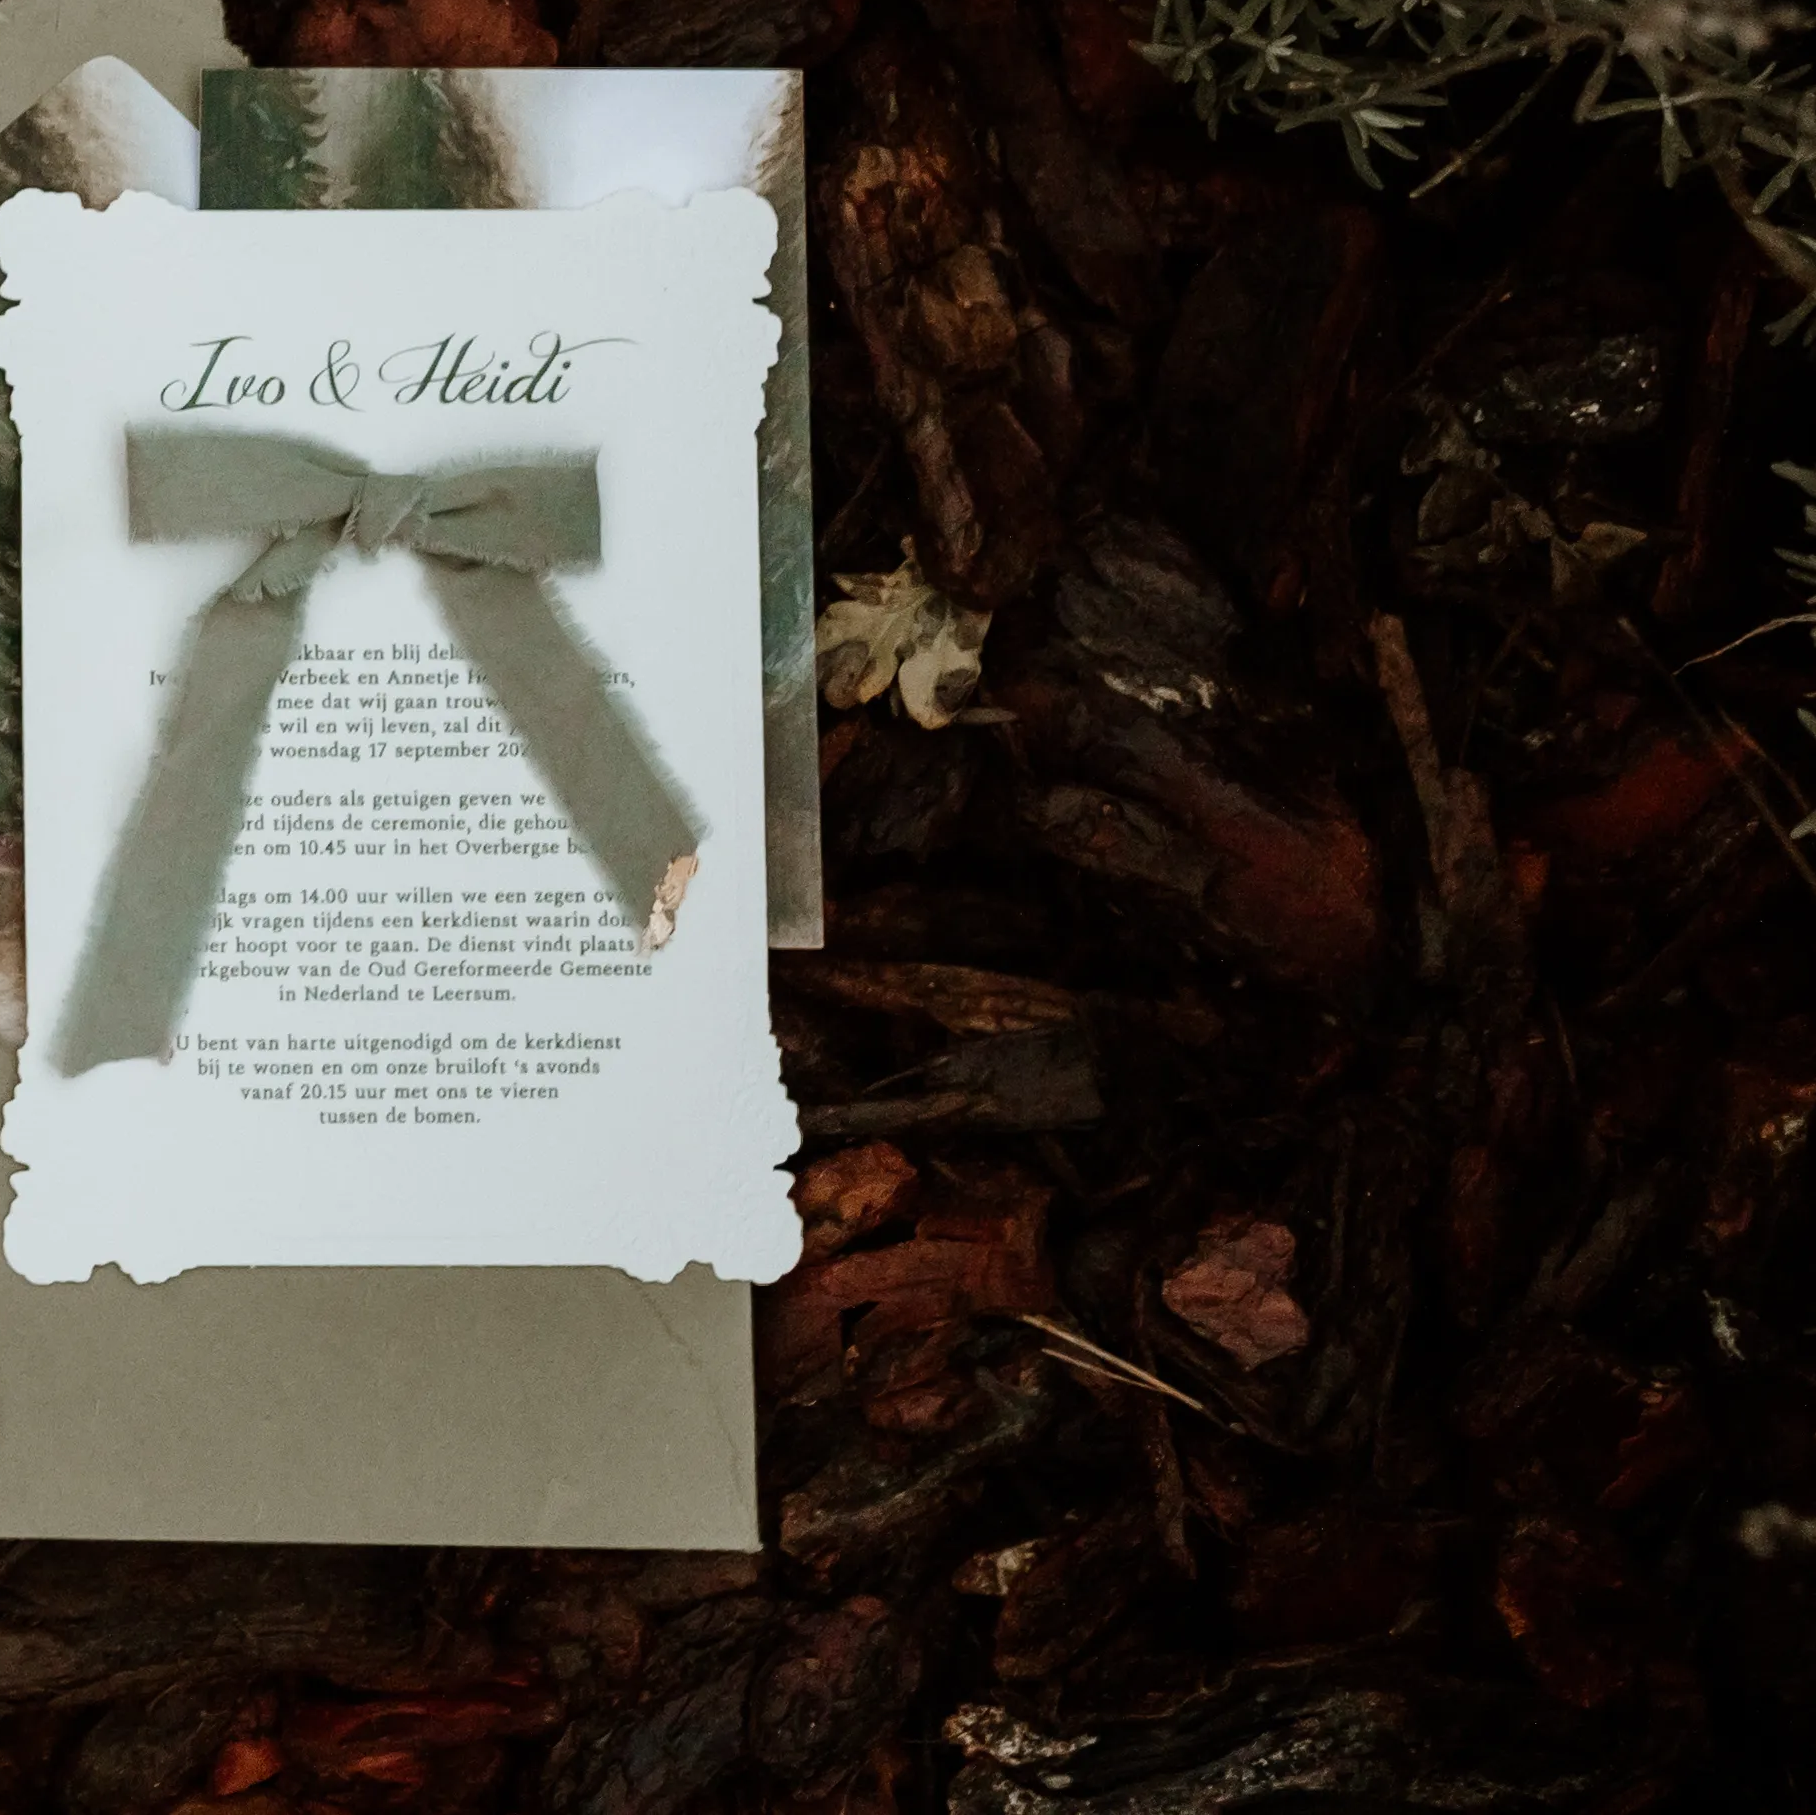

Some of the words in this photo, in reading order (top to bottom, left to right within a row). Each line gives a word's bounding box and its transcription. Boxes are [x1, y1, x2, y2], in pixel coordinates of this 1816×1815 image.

[159, 335, 286, 413] Ivo
[309, 339, 366, 413] &
[377, 330, 639, 405] Heidi
[298, 643, 356, 661] kbaar
[362, 648, 385, 661] en
[391, 643, 421, 665] blij
[357, 673, 380, 686] en
[385, 668, 460, 689] Annetje
[276, 697, 315, 710] mee
[321, 691, 351, 710] dat
[358, 691, 388, 714] wij
[393, 696, 438, 715] gaan
[278, 716, 308, 734] wil
[315, 721, 338, 734] en
[345, 716, 374, 739] wij
[380, 716, 437, 738] leven,
[442, 715, 469, 734] zal
[476, 715, 502, 733] dit
[268, 740, 362, 763] woensdag
[368, 741, 388, 759] 17
[394, 740, 491, 763] september
[270, 788, 333, 808] ouders
[339, 788, 366, 808] als
[372, 789, 452, 812] getuigen
[458, 793, 513, 812] geven
[519, 793, 546, 807] we
[272, 813, 335, 837] tijdens
[341, 812, 364, 832] de
[370, 813, 472, 836] ceremonie,
[477, 811, 507, 832] die
[514, 812, 569, 836] gehou
[262, 843, 291, 856] om
[299, 838, 347, 856] 10.45
[353, 843, 387, 856] uur
[393, 837, 411, 856] in
[418, 837, 449, 856] het
[455, 836, 561, 860] Overbergse
[264, 891, 292, 905] om
[300, 887, 349, 905] 14.00
[356, 891, 389, 905] uur
[395, 886, 453, 905] willen
[460, 891, 488, 904] we
[494, 891, 527, 904] een
[533, 890, 586, 909] zegen
[240, 916, 305, 934] vragen
[312, 910, 374, 933] tijdens
[381, 915, 414, 929] een
[421, 909, 519, 929] kerkdienst
[525, 910, 591, 929] waarin
[235, 935, 288, 958] hoopt
[295, 940, 338, 953] voor
[345, 939, 363, 953] te
[369, 940, 420, 958] gaan.
[427, 936, 453, 953] De
[458, 934, 516, 953] dienst
[522, 933, 572, 953] vindt
[580, 934, 635, 957] plaats
[198, 960, 291, 982] rkgebouw
[297, 964, 332, 978] van
[338, 959, 361, 977] de
[367, 958, 407, 978] Oud
[413, 958, 553, 978] Gereformeerde
[559, 959, 653, 977] Gemeente
[278, 984, 297, 1002] in
[304, 983, 399, 1002] Nederland
[407, 988, 425, 1002] te
[431, 984, 516, 1002] Leersum.
[175, 1034, 190, 1051] U
[197, 1032, 239, 1052] bent
[245, 1037, 280, 1052] van
[287, 1033, 337, 1052] harte
[343, 1032, 453, 1056] uitgenodigd
[459, 1037, 489, 1051] om
[495, 1032, 518, 1051] de
[524, 1031, 622, 1051] kerkdienst
[197, 1057, 221, 1080] bij
[227, 1062, 246, 1076] te
[252, 1062, 314, 1076] wonen
[321, 1063, 344, 1076] en
[350, 1062, 379, 1076] om
[385, 1062, 429, 1076] onze
[434, 1055, 507, 1076] bruiloft
[535, 1056, 601, 1075] avonds
[240, 1081, 295, 1101] vanaf
[300, 1082, 348, 1100] 20.15
[355, 1087, 387, 1100] uur
[393, 1086, 429, 1100] met
[436, 1086, 468, 1100] ons
[475, 1085, 494, 1100] te
[499, 1081, 559, 1100] vieren
[319, 1111, 378, 1125] tussen
[385, 1105, 407, 1124] de
[413, 1105, 481, 1125] bomen.
